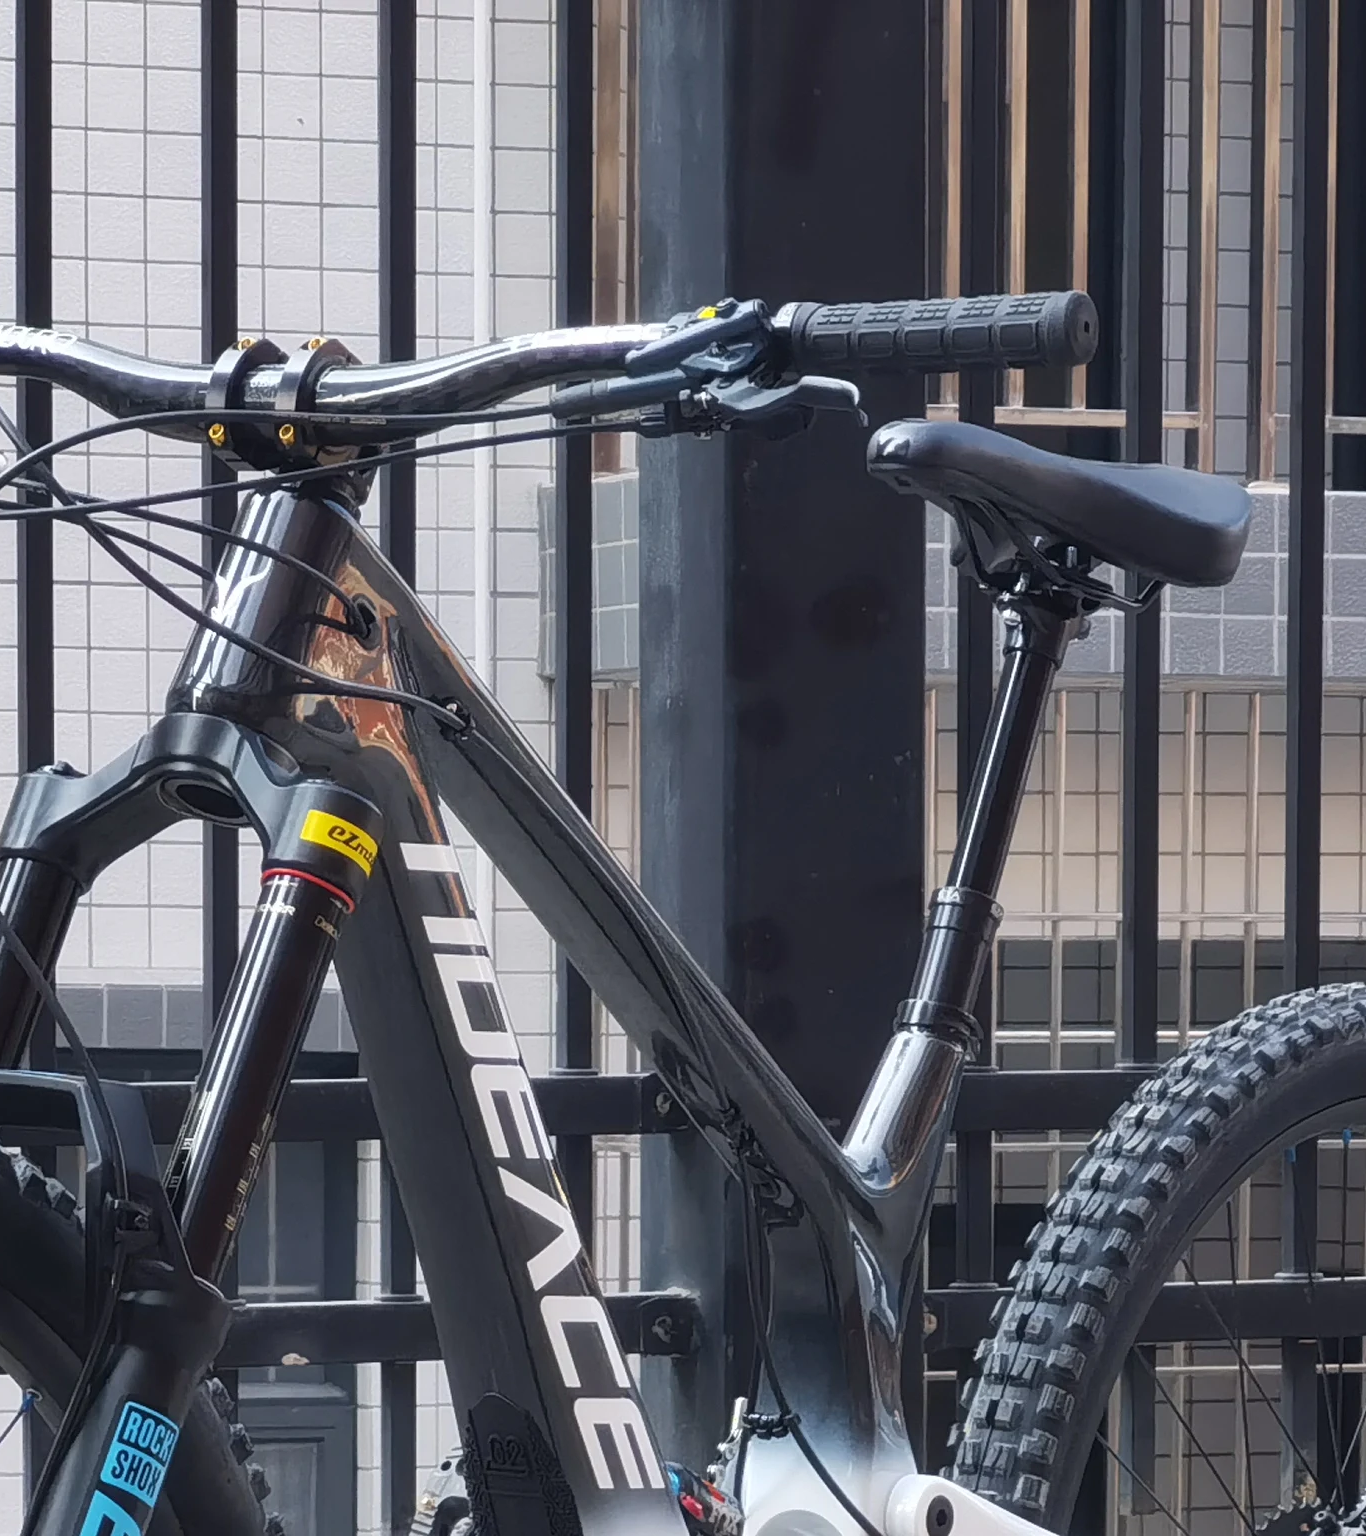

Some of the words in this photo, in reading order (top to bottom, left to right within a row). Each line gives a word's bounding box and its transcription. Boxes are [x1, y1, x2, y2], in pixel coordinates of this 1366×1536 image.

[401, 842, 665, 1490] TIDEACE
[123, 1411, 175, 1462] ROCK
[110, 1449, 162, 1499] SHOX
